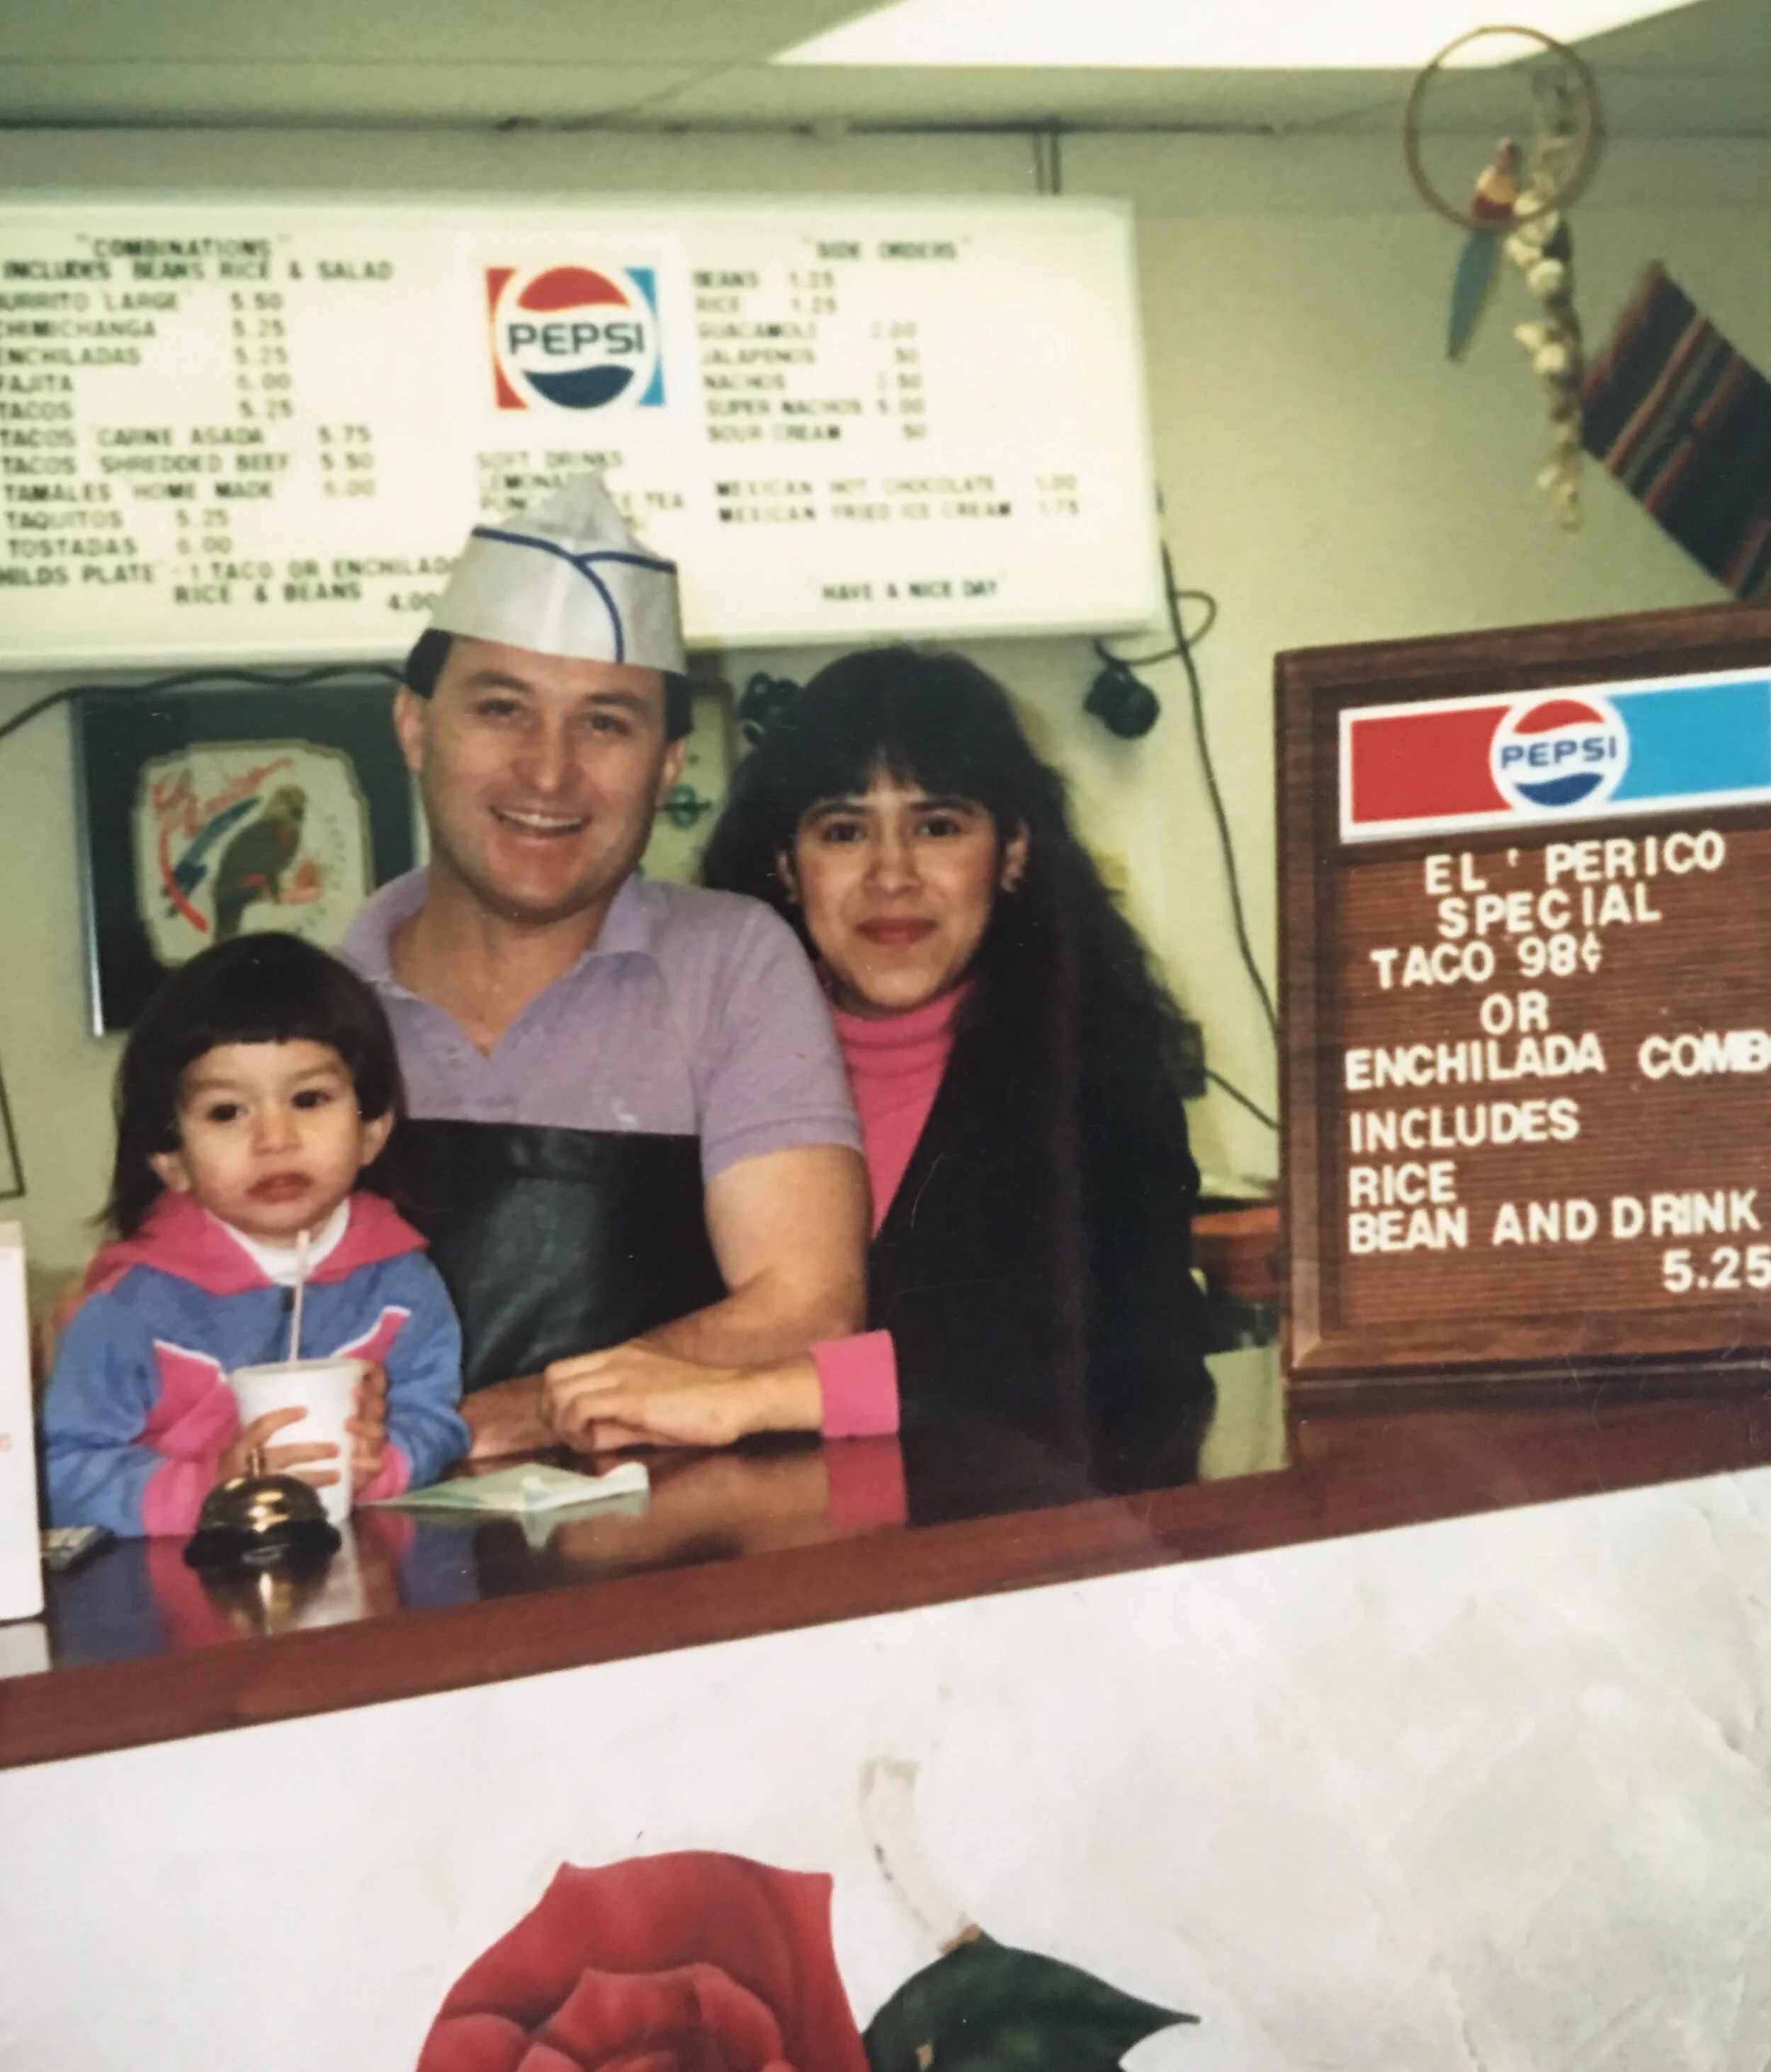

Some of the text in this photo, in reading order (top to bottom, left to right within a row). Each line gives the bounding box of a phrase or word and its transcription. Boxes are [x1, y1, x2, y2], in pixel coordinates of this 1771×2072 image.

[3, 260, 393, 281] INCLUDES BEANS RICE & SALAD
[692, 269, 759, 288] BEANS
[0, 291, 90, 312] URRITO
[695, 295, 740, 314] RICE
[0, 318, 157, 339] HIMICHANGA
[507, 322, 645, 355] PEPSI
[698, 321, 817, 340] GUACAMOLE
[702, 372, 786, 390] NACHOS
[0, 400, 74, 421] TACOS
[706, 398, 770, 417] SUPER
[781, 398, 863, 417] NACHOS
[1, 427, 77, 449] TACOS
[707, 424, 762, 444] SOUR
[771, 424, 842, 442] CREAM
[1, 455, 77, 475] TACOS
[479, 473, 563, 489] LEMONA
[713, 478, 813, 497] MEXICAN
[830, 477, 867, 494] HOT
[883, 475, 995, 495] CHOCOLATE
[3, 482, 111, 504] TAMALES
[5, 508, 230, 531] TAQUITOS 5.25
[718, 504, 817, 524] MEXICAN
[832, 502, 890, 522] FRIED
[902, 502, 930, 521] ICE
[941, 500, 1013, 521] CREAM
[7, 537, 138, 559] TOSTADAS
[0, 565, 69, 587] HILDS
[211, 560, 274, 580] TACO
[287, 558, 320, 579] OR
[173, 582, 231, 604] RICE
[254, 582, 269, 604] &
[283, 581, 362, 603] BEANS
[886, 582, 899, 599] A
[907, 580, 952, 599] NICE
[1500, 735, 1617, 770] PEPSI
[1424, 852, 1486, 895] EL
[1545, 830, 1726, 885] PERICO
[1437, 883, 1663, 939] SPECIAL
[1370, 932, 1603, 990] TACO 98¢
[1480, 990, 1550, 1035] OR
[1345, 1030, 1771, 1091] ENCHILADA COMB
[1349, 1098, 1580, 1154] INCLUDES
[1349, 1161, 1458, 1207] RICE
[1349, 1189, 1762, 1256] BEAN AND DRINK
[1662, 1245, 1771, 1293] 5.25
